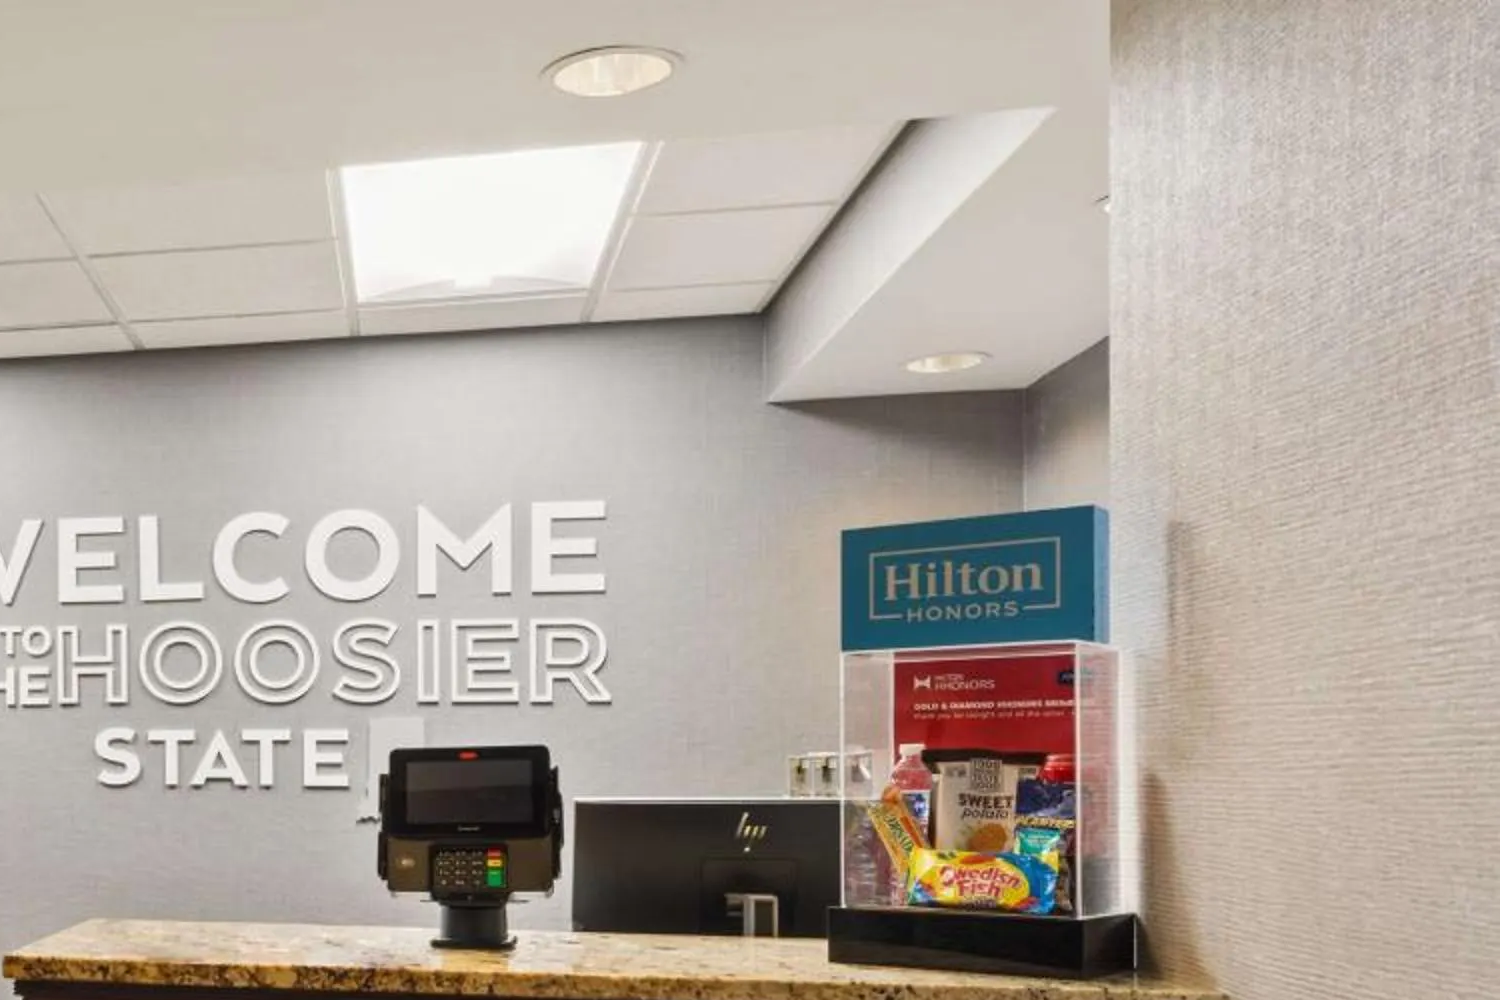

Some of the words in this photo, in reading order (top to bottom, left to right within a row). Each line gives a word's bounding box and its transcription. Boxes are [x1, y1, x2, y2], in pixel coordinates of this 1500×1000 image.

[884, 559, 1044, 601] Hilton
[906, 600, 1019, 623] HONORS
[56, 617, 613, 705] HOOSIER
[94, 727, 350, 788] STATE
[957, 792, 1014, 809] SWEET
[938, 865, 1021, 888] Swedish
[955, 879, 1001, 897] Fish
